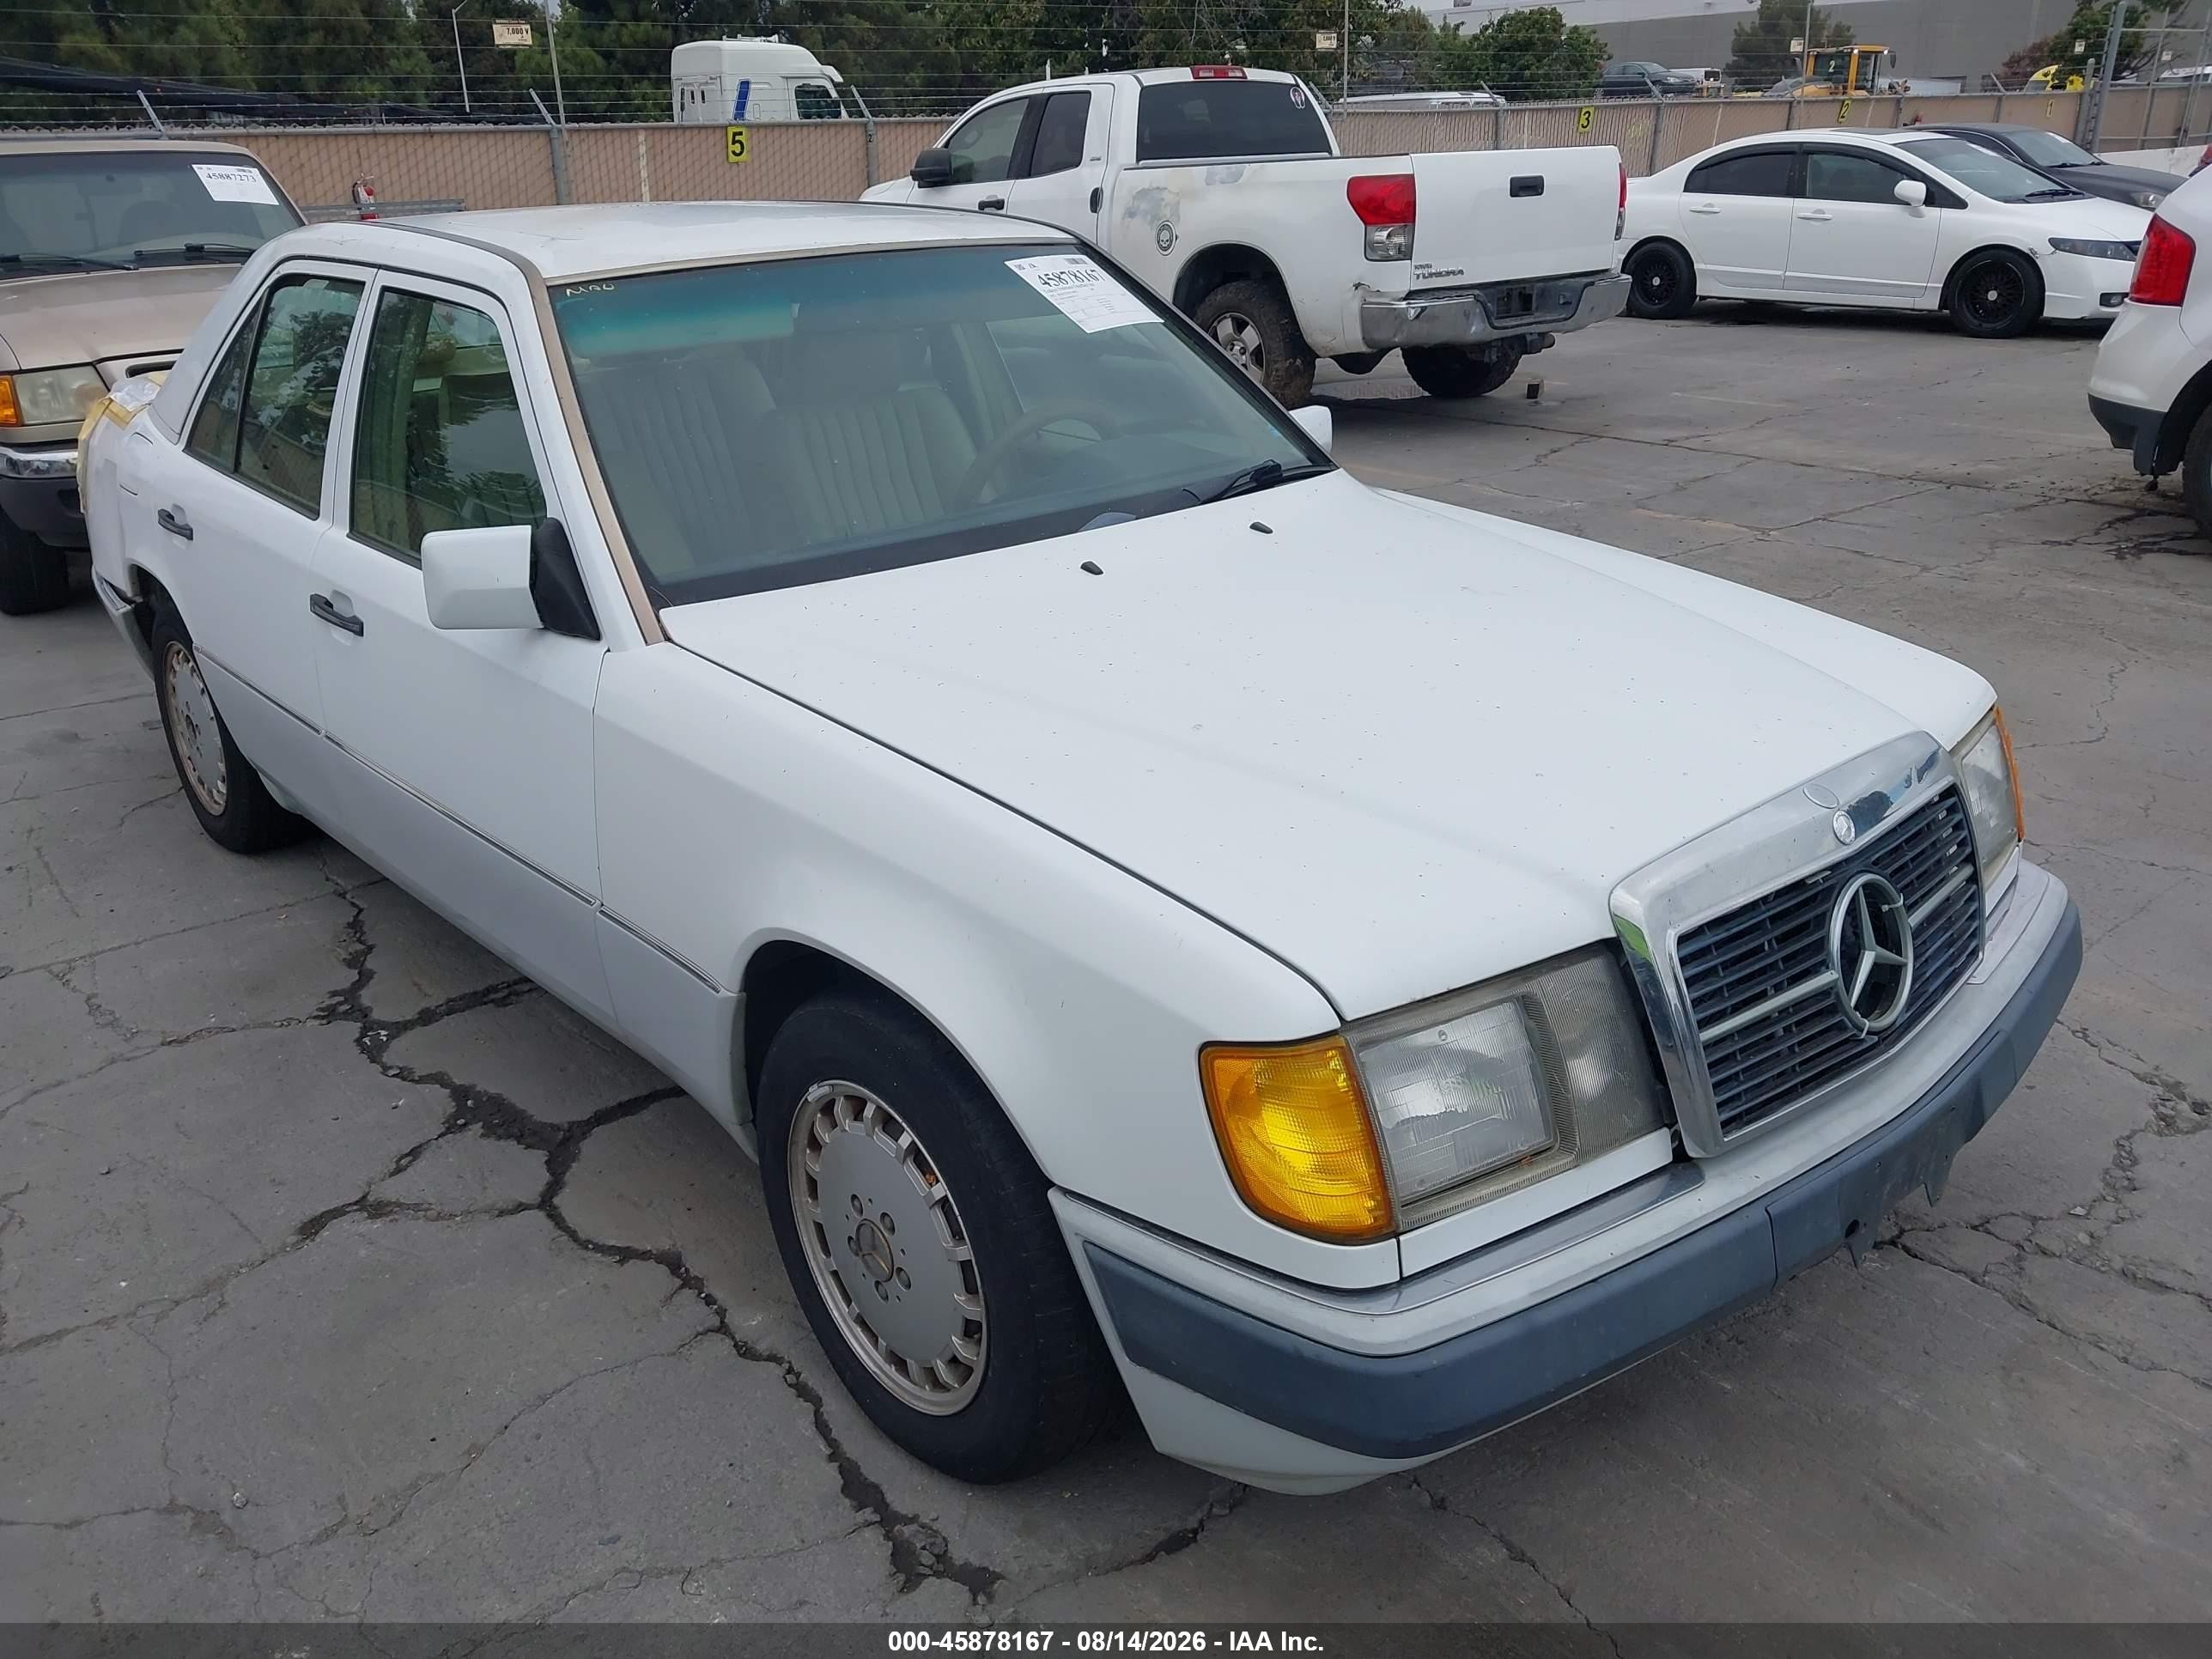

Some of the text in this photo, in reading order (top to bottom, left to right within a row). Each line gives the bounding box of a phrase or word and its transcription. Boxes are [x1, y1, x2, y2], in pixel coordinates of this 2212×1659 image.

[1828, 60, 1836, 72] 2
[1840, 102, 1850, 118] 2
[1581, 110, 1591, 129] 3
[731, 131, 745, 157] 5
[206, 173, 257, 183] 45887273
[1038, 269, 1105, 288] 45878167
[1413, 268, 1465, 280] TUNDRA
